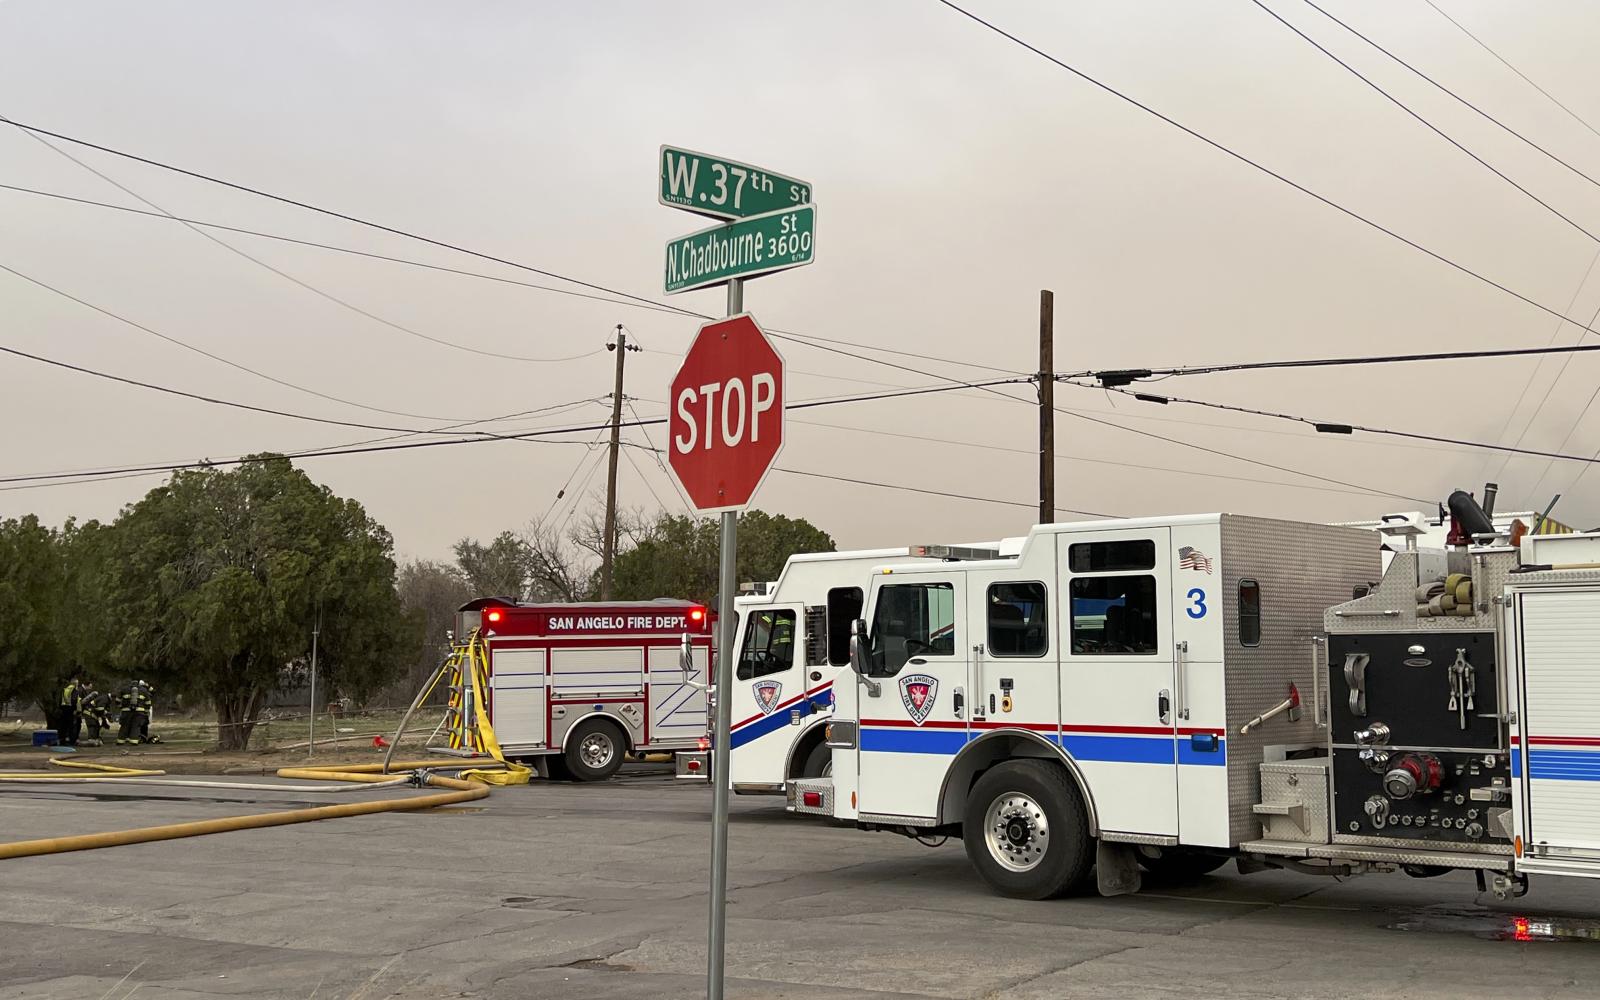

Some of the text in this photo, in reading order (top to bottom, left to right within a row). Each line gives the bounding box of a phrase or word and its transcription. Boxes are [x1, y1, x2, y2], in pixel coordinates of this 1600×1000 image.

[666, 153, 808, 208] W.37th St
[781, 213, 797, 234] St
[667, 231, 811, 284] N.Chadbourne 3600
[675, 372, 776, 454] STOP
[1186, 588, 1207, 619] 3
[549, 616, 688, 630] SAN ANGELO FIRE DEPT.
[901, 676, 935, 686] SAN ANGELO
[903, 694, 911, 707] FIRE
